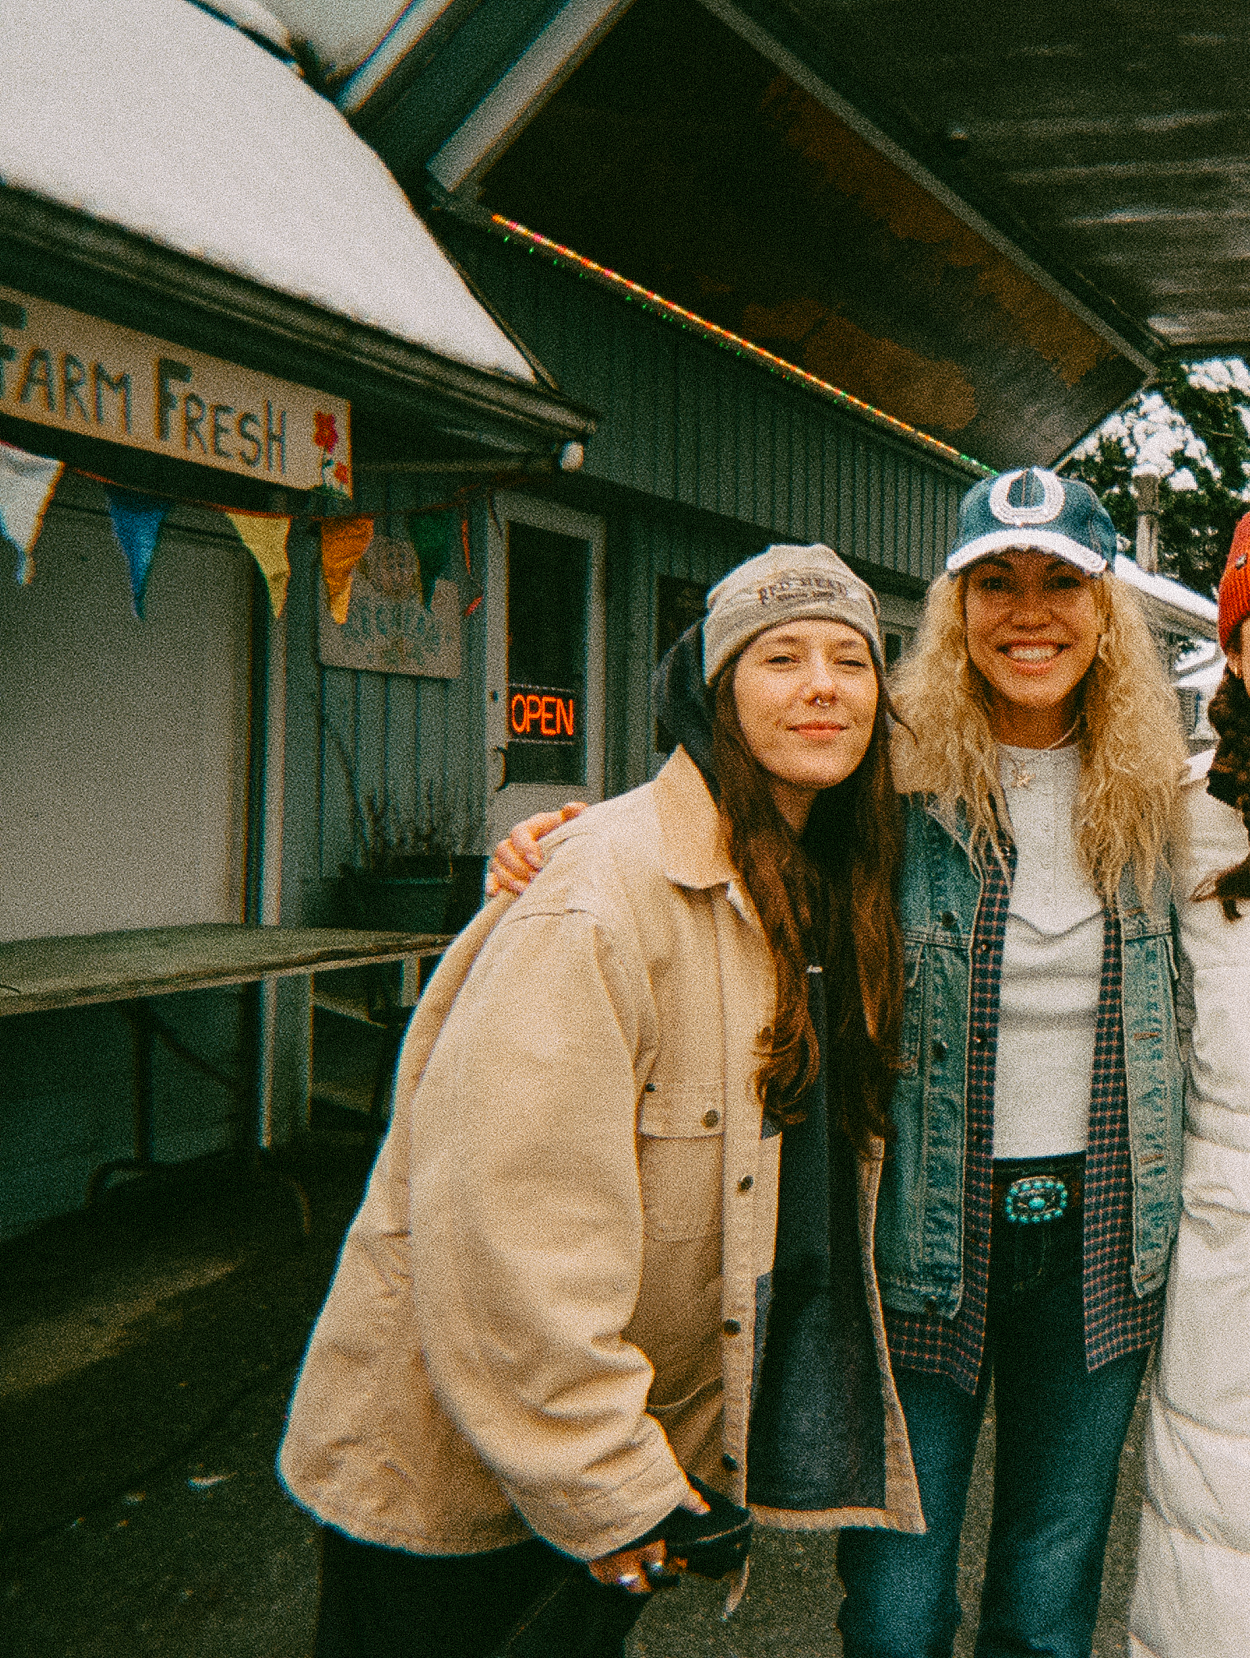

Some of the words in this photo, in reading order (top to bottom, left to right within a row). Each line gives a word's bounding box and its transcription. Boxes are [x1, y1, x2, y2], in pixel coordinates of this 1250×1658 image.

[0, 300, 131, 434] FARM
[155, 357, 286, 475] FRESH
[511, 692, 574, 736] OPEN
